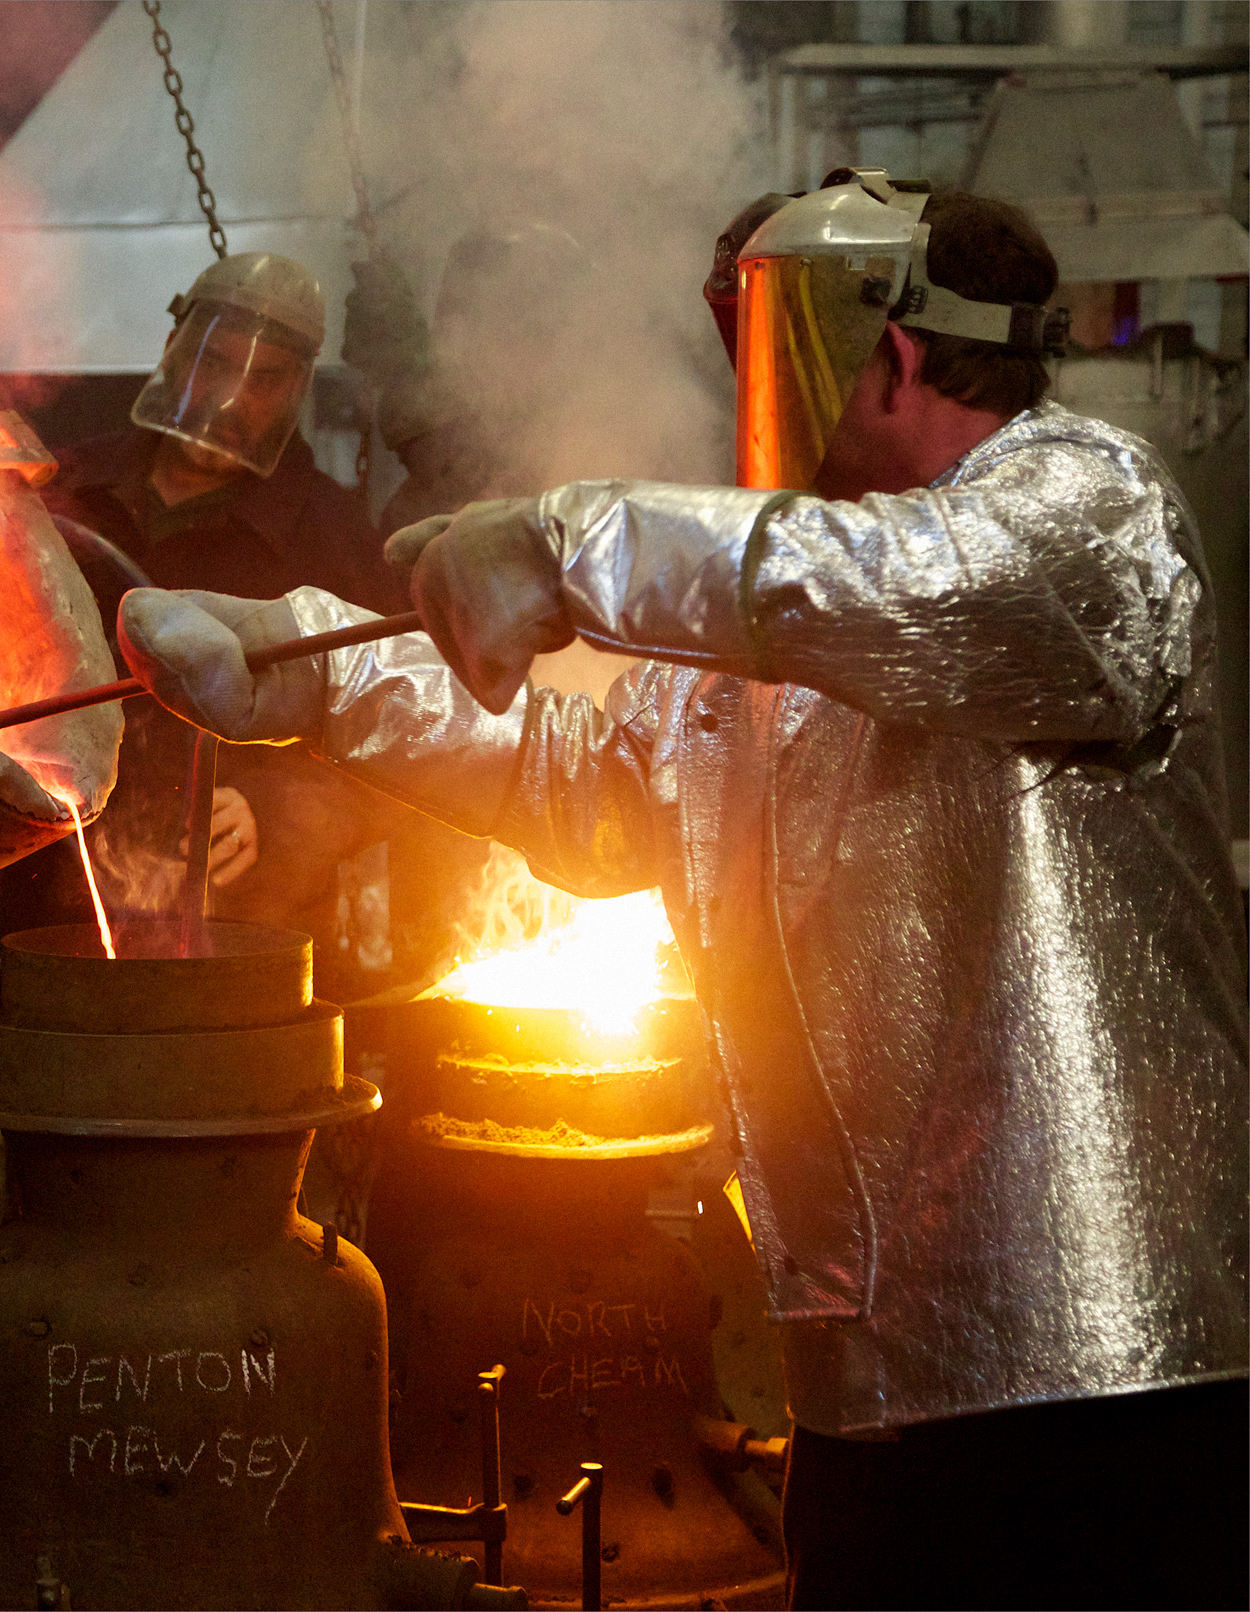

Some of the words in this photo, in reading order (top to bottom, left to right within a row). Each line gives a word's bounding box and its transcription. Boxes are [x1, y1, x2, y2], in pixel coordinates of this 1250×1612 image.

[522, 1298, 668, 1348] NORTH
[46, 1342, 278, 1415] PENTON
[536, 1353, 691, 1400] CHEAM
[68, 1425, 308, 1527] MEWSEY
